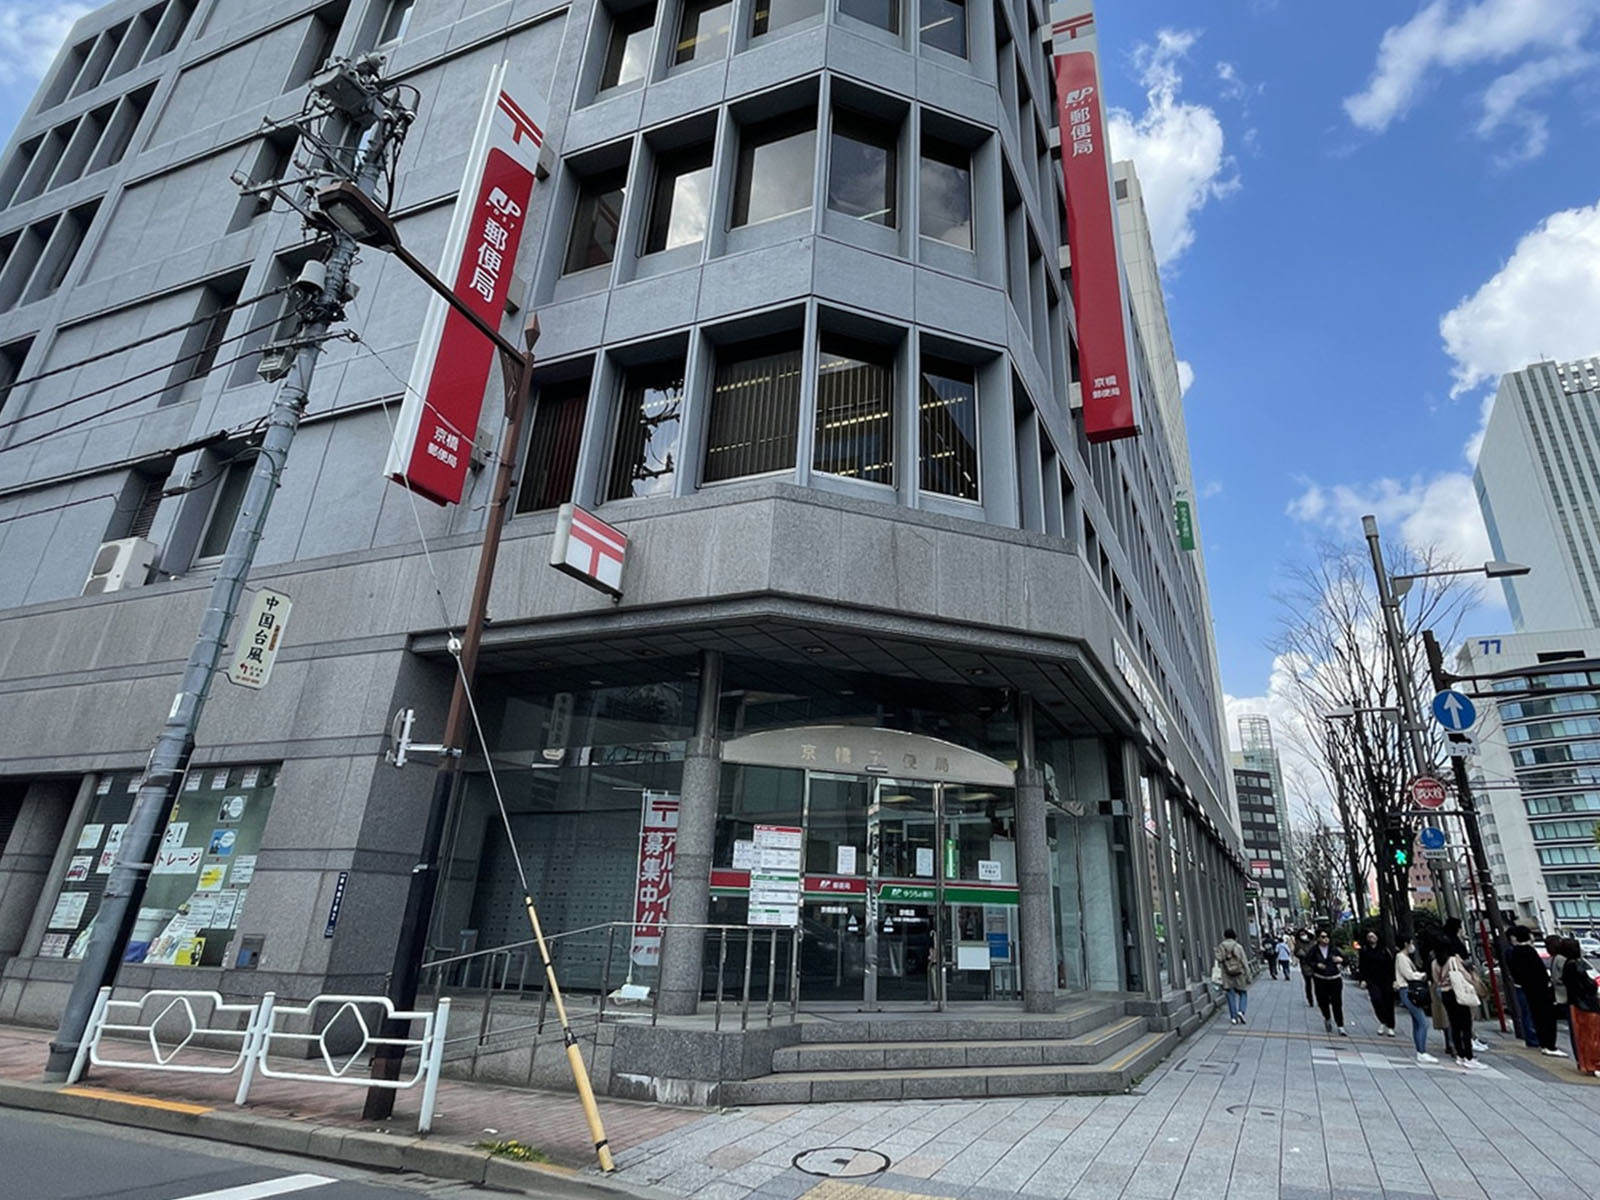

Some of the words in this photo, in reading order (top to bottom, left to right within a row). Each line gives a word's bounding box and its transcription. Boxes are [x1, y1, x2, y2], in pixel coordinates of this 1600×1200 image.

[1070, 107, 1094, 158] 郵便局
[470, 216, 509, 303] 郵便局
[427, 441, 458, 469] 郵便局
[433, 425, 459, 452] 京橋
